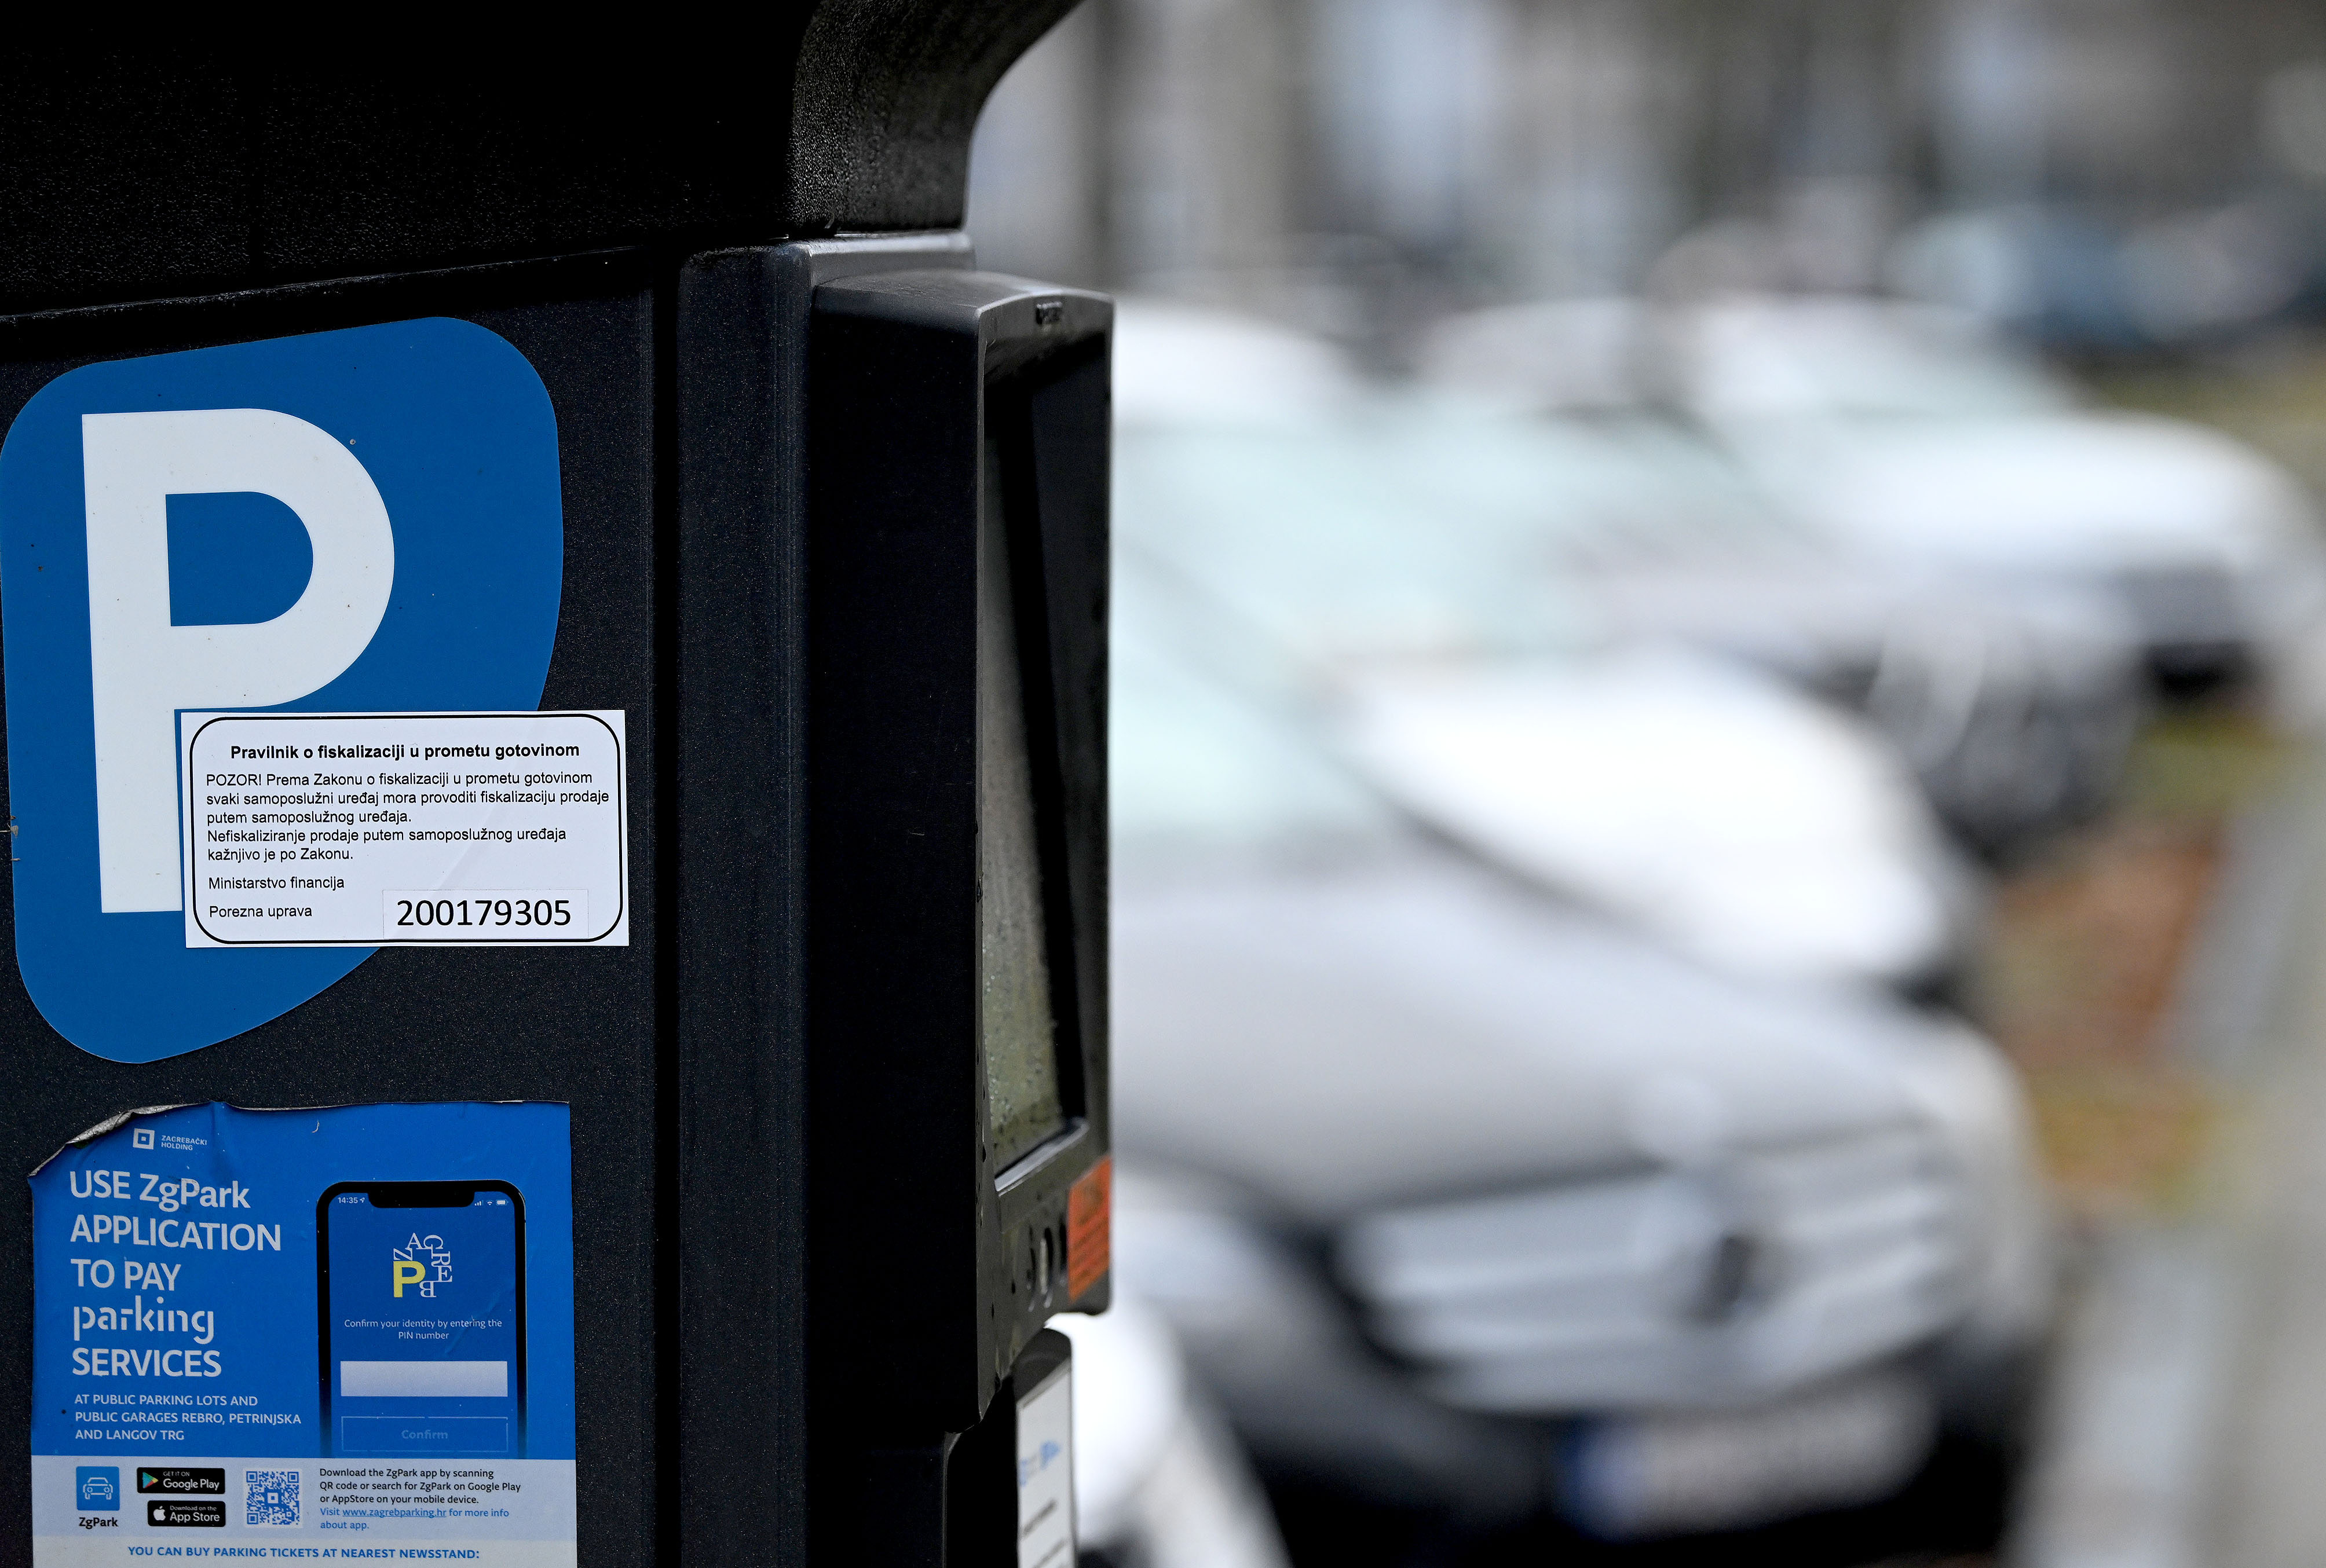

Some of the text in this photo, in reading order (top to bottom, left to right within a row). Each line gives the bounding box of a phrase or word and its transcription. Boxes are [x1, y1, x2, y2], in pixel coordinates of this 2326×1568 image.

[82, 408, 395, 913] P
[232, 743, 579, 761] Pravilnik o fiskalizaciji u prometu gotovinom
[207, 771, 592, 787] POZOR! Prema Zakonu o fiskalizaciji u prometu gotovinom
[207, 790, 609, 807] svaki samoposlužni uređaj mora provoditi fiskalizaciju prodaje
[208, 810, 411, 826] putem samoposlužnog uređaja.
[208, 828, 566, 844] Nefiskaliziranje prodaje putem samoposlužnog uređaja
[209, 848, 353, 863] kažnjivo je po Zakonu.
[209, 876, 344, 891] Ministarstvo financija
[210, 906, 312, 919] Porezna uprava
[398, 900, 570, 925] 200179305
[161, 1135, 207, 1145] ZAGREBAČKI
[161, 1142, 193, 1151] HOLDING
[70, 1170, 250, 1212] USE ZgPark
[71, 1215, 280, 1251] APPLICATION
[71, 1259, 181, 1291] TO PAY
[74, 1295, 214, 1344] parking
[403, 1320, 435, 1329] identity
[438, 1320, 448, 1329] by
[451, 1319, 485, 1329] entering
[399, 1331, 413, 1339] PIN
[73, 1348, 221, 1377] SERVICES
[75, 1394, 258, 1405] AT PUBLIC PARKING LOTS AND
[76, 1412, 301, 1425] PUBLIC GARAGES REBRO, PETRINJSKA
[75, 1430, 184, 1440] AND LANGOV TRG
[401, 1430, 448, 1439] Confirm
[369, 1468, 383, 1477] the
[386, 1469, 418, 1479] ZgPark
[420, 1471, 437, 1479] app
[440, 1469, 450, 1479] by
[454, 1469, 493, 1479] scanning
[163, 1478, 220, 1490] Google Play
[320, 1482, 333, 1491] QR
[405, 1482, 417, 1490] for
[420, 1482, 451, 1492] ZgPark
[468, 1483, 499, 1492] Google
[503, 1483, 521, 1493] Play
[332, 1495, 374, 1504] AppStore
[391, 1497, 411, 1505] your
[414, 1495, 444, 1503] mobile
[448, 1495, 478, 1503] device.
[170, 1512, 220, 1523] App Store
[342, 1508, 447, 1518] www.zagrebparking.hr
[491, 1508, 509, 1516] info
[79, 1517, 118, 1529] ZgPark
[350, 1523, 369, 1531] app.
[128, 1547, 479, 1558] YOU CAN BUY PARKING TICKETS AT NEAREST NEWSSTAND:
